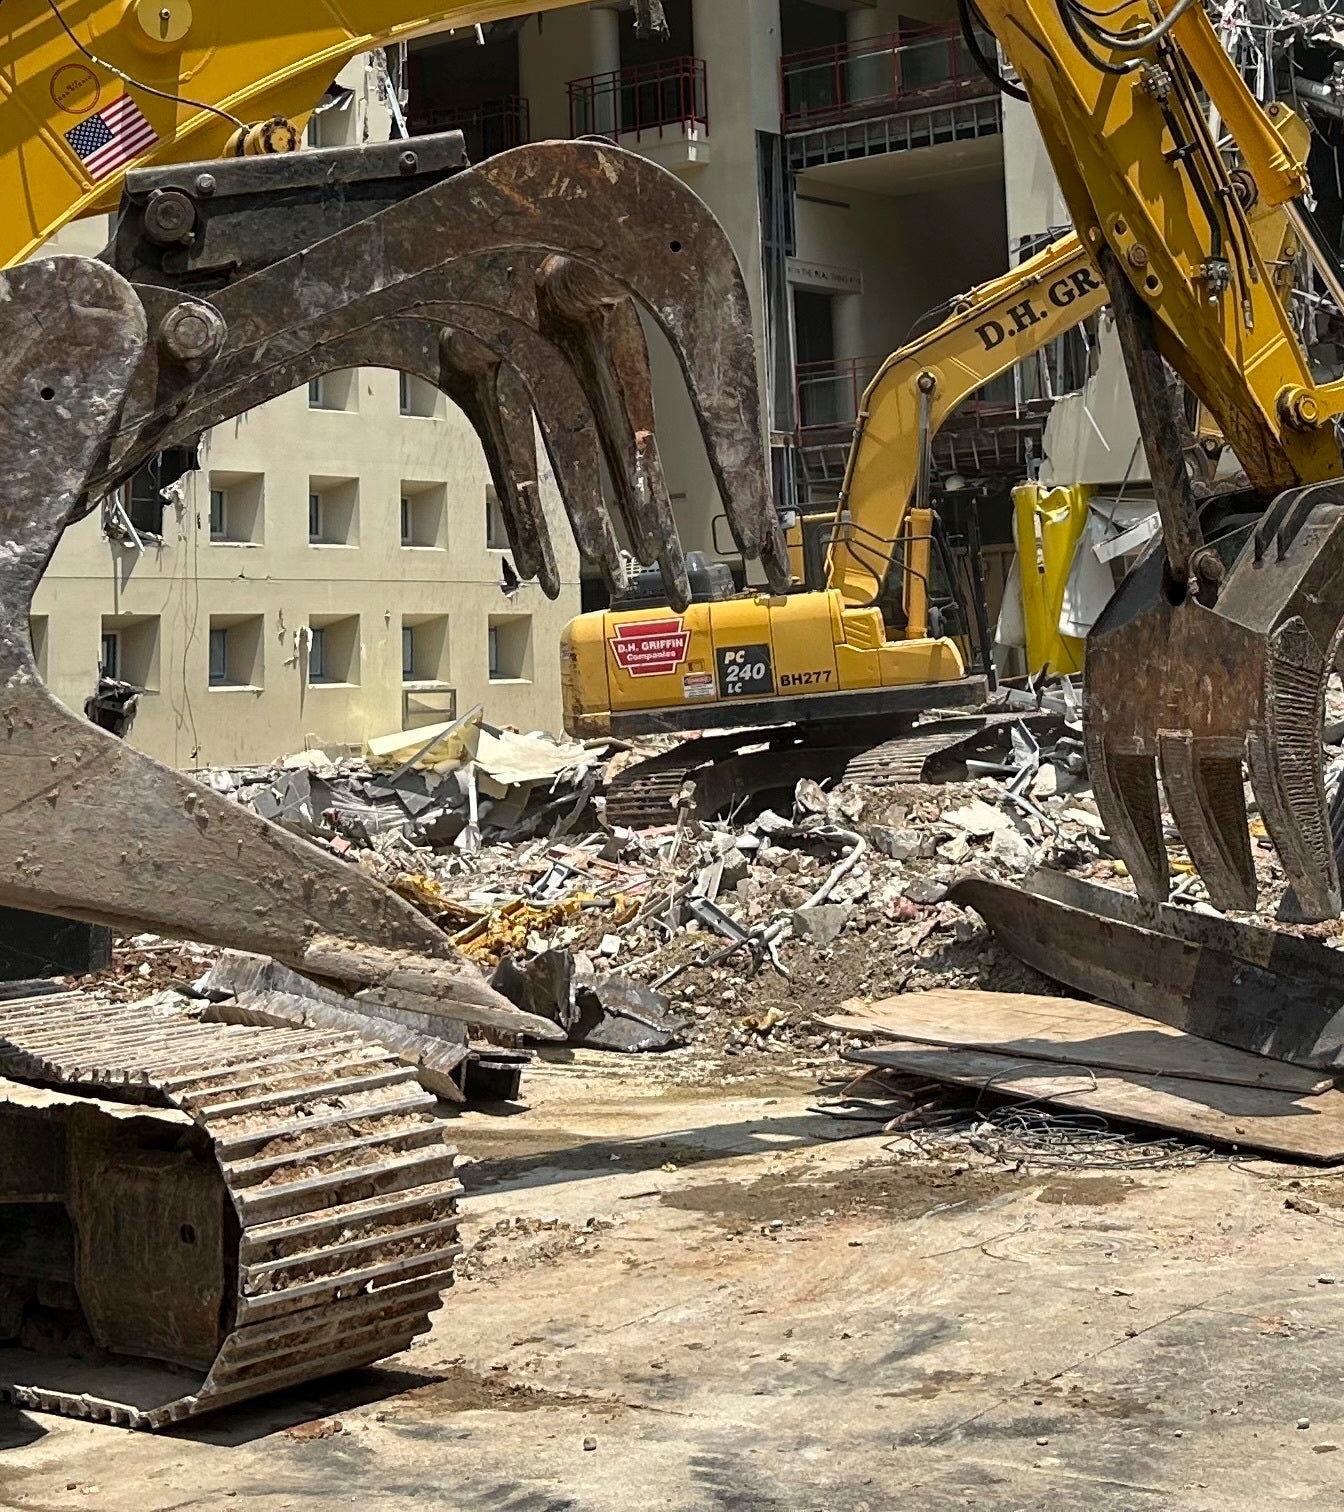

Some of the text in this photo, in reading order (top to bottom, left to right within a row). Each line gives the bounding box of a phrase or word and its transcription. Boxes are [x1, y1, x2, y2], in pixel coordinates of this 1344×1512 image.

[974, 268, 1104, 351] D.H. GR
[617, 638, 684, 653] D.H. GRIFFIN
[626, 650, 676, 661] Companies
[724, 650, 746, 664] PC
[726, 662, 766, 682] 240
[780, 670, 832, 687] BH277
[727, 682, 743, 694] LC
